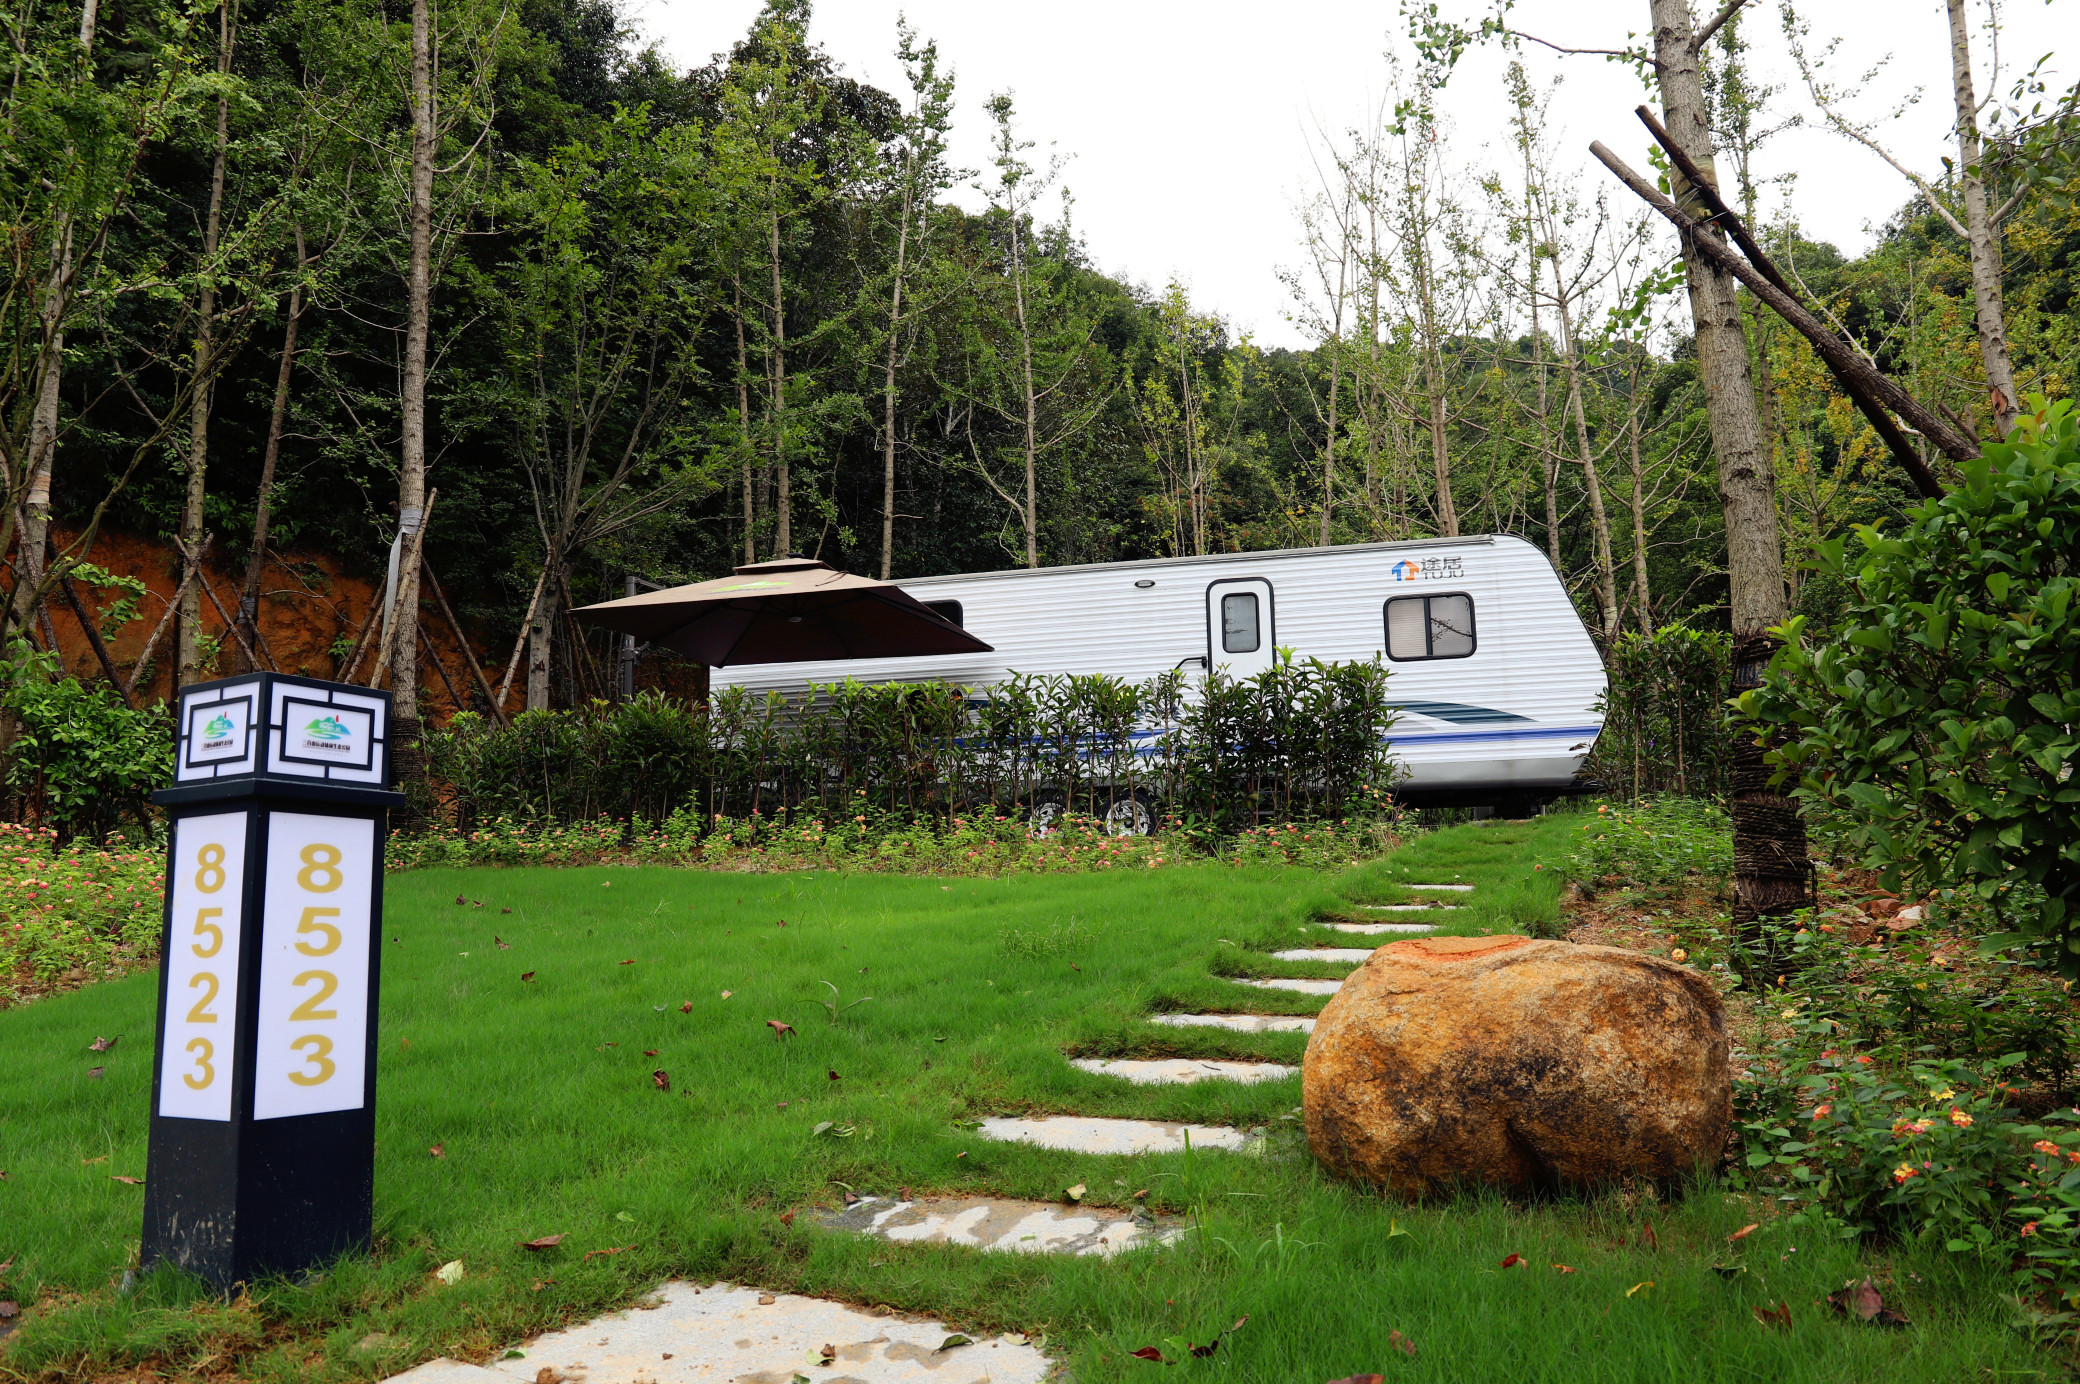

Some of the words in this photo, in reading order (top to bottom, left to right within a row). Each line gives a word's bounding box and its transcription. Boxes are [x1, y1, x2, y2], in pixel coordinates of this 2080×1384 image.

[1421, 556, 1462, 572] 途居
[1422, 570, 1464, 580] TUJU
[184, 844, 226, 1090] 8523
[289, 844, 343, 1086] 8523
